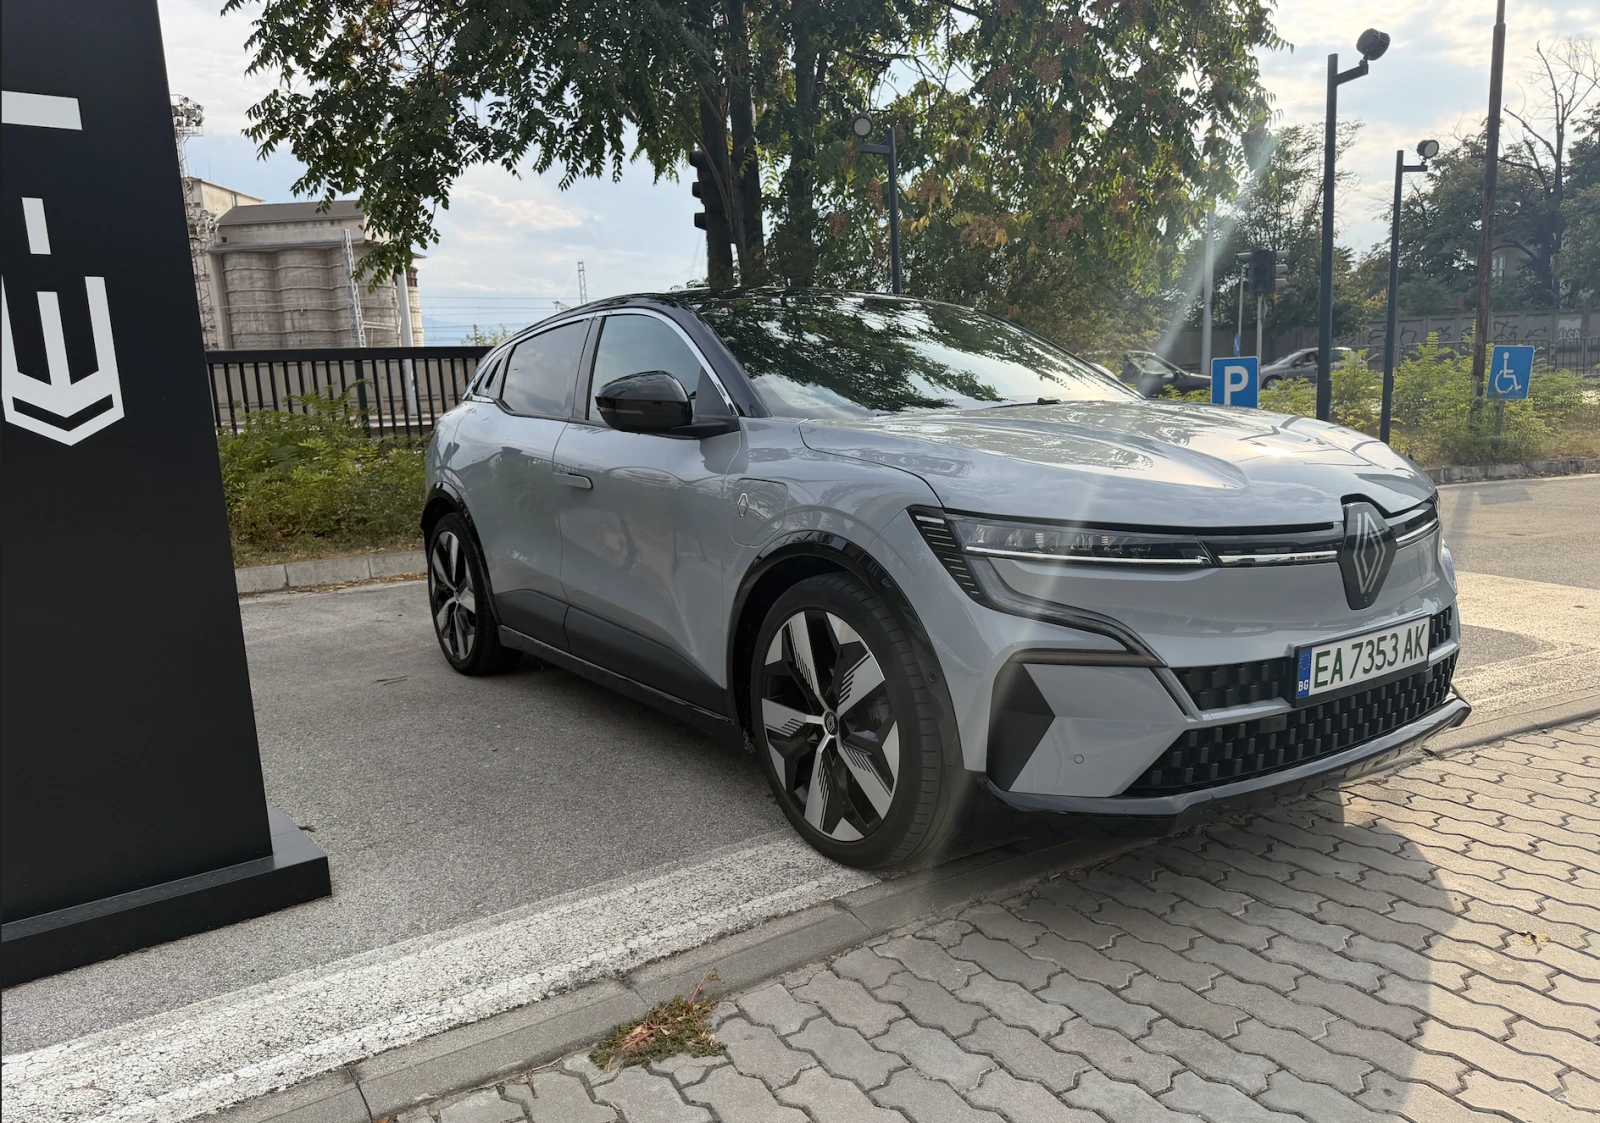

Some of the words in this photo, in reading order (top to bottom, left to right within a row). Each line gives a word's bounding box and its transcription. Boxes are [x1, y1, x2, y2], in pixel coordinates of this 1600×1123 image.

[1224, 365, 1249, 405] P
[1314, 647, 1343, 688] EA
[1349, 632, 1399, 679] 7353
[1402, 623, 1426, 663] AK
[1298, 679, 1309, 692] BG
